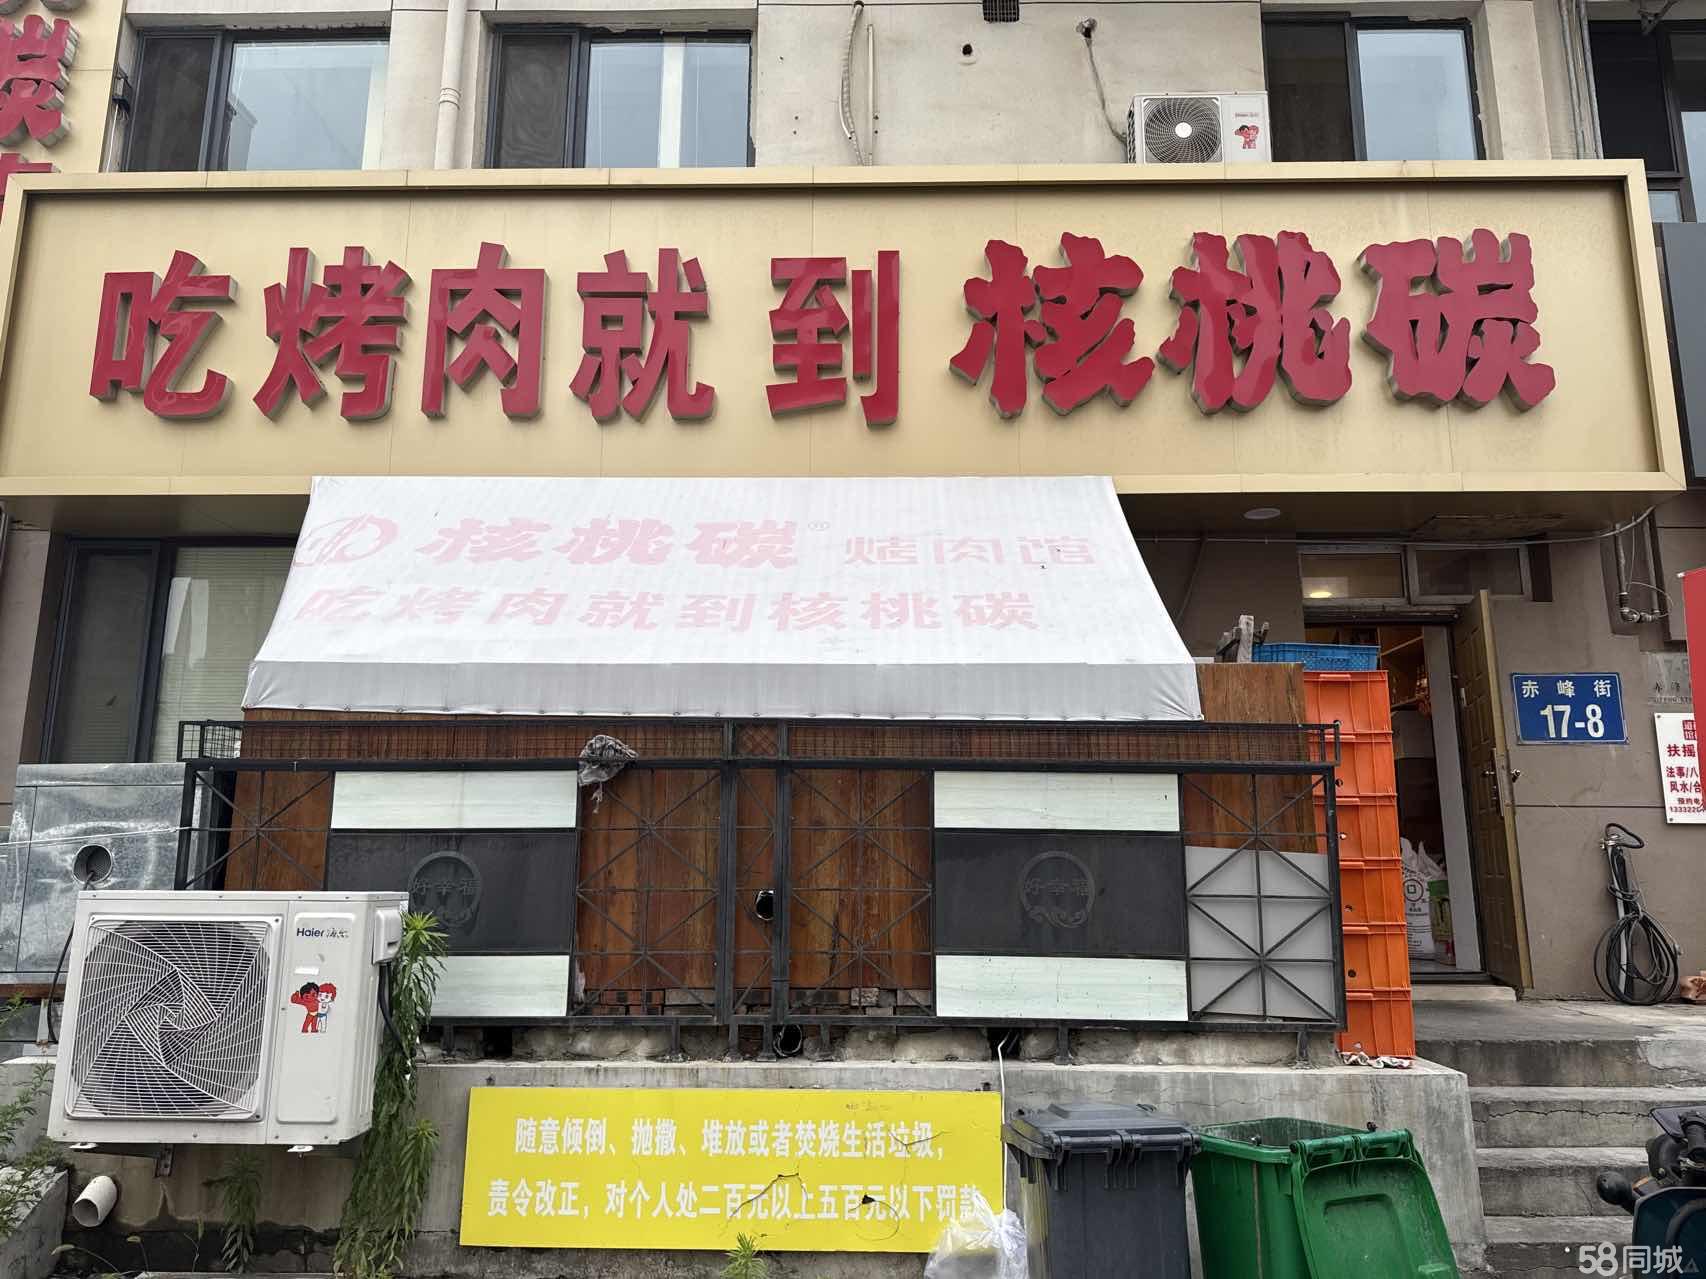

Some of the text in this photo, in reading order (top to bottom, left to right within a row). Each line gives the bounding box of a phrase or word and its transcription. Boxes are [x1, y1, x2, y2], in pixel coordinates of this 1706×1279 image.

[89, 229, 1557, 427] 吃烤肉就到核桃碳
[416, 516, 798, 569] 核桃碳
[295, 586, 1039, 632] 吃烤肉就到核桃碳
[1521, 679, 1612, 698] 赤峰街
[1539, 704, 1605, 738] 17-8
[296, 928, 325, 937] Haier
